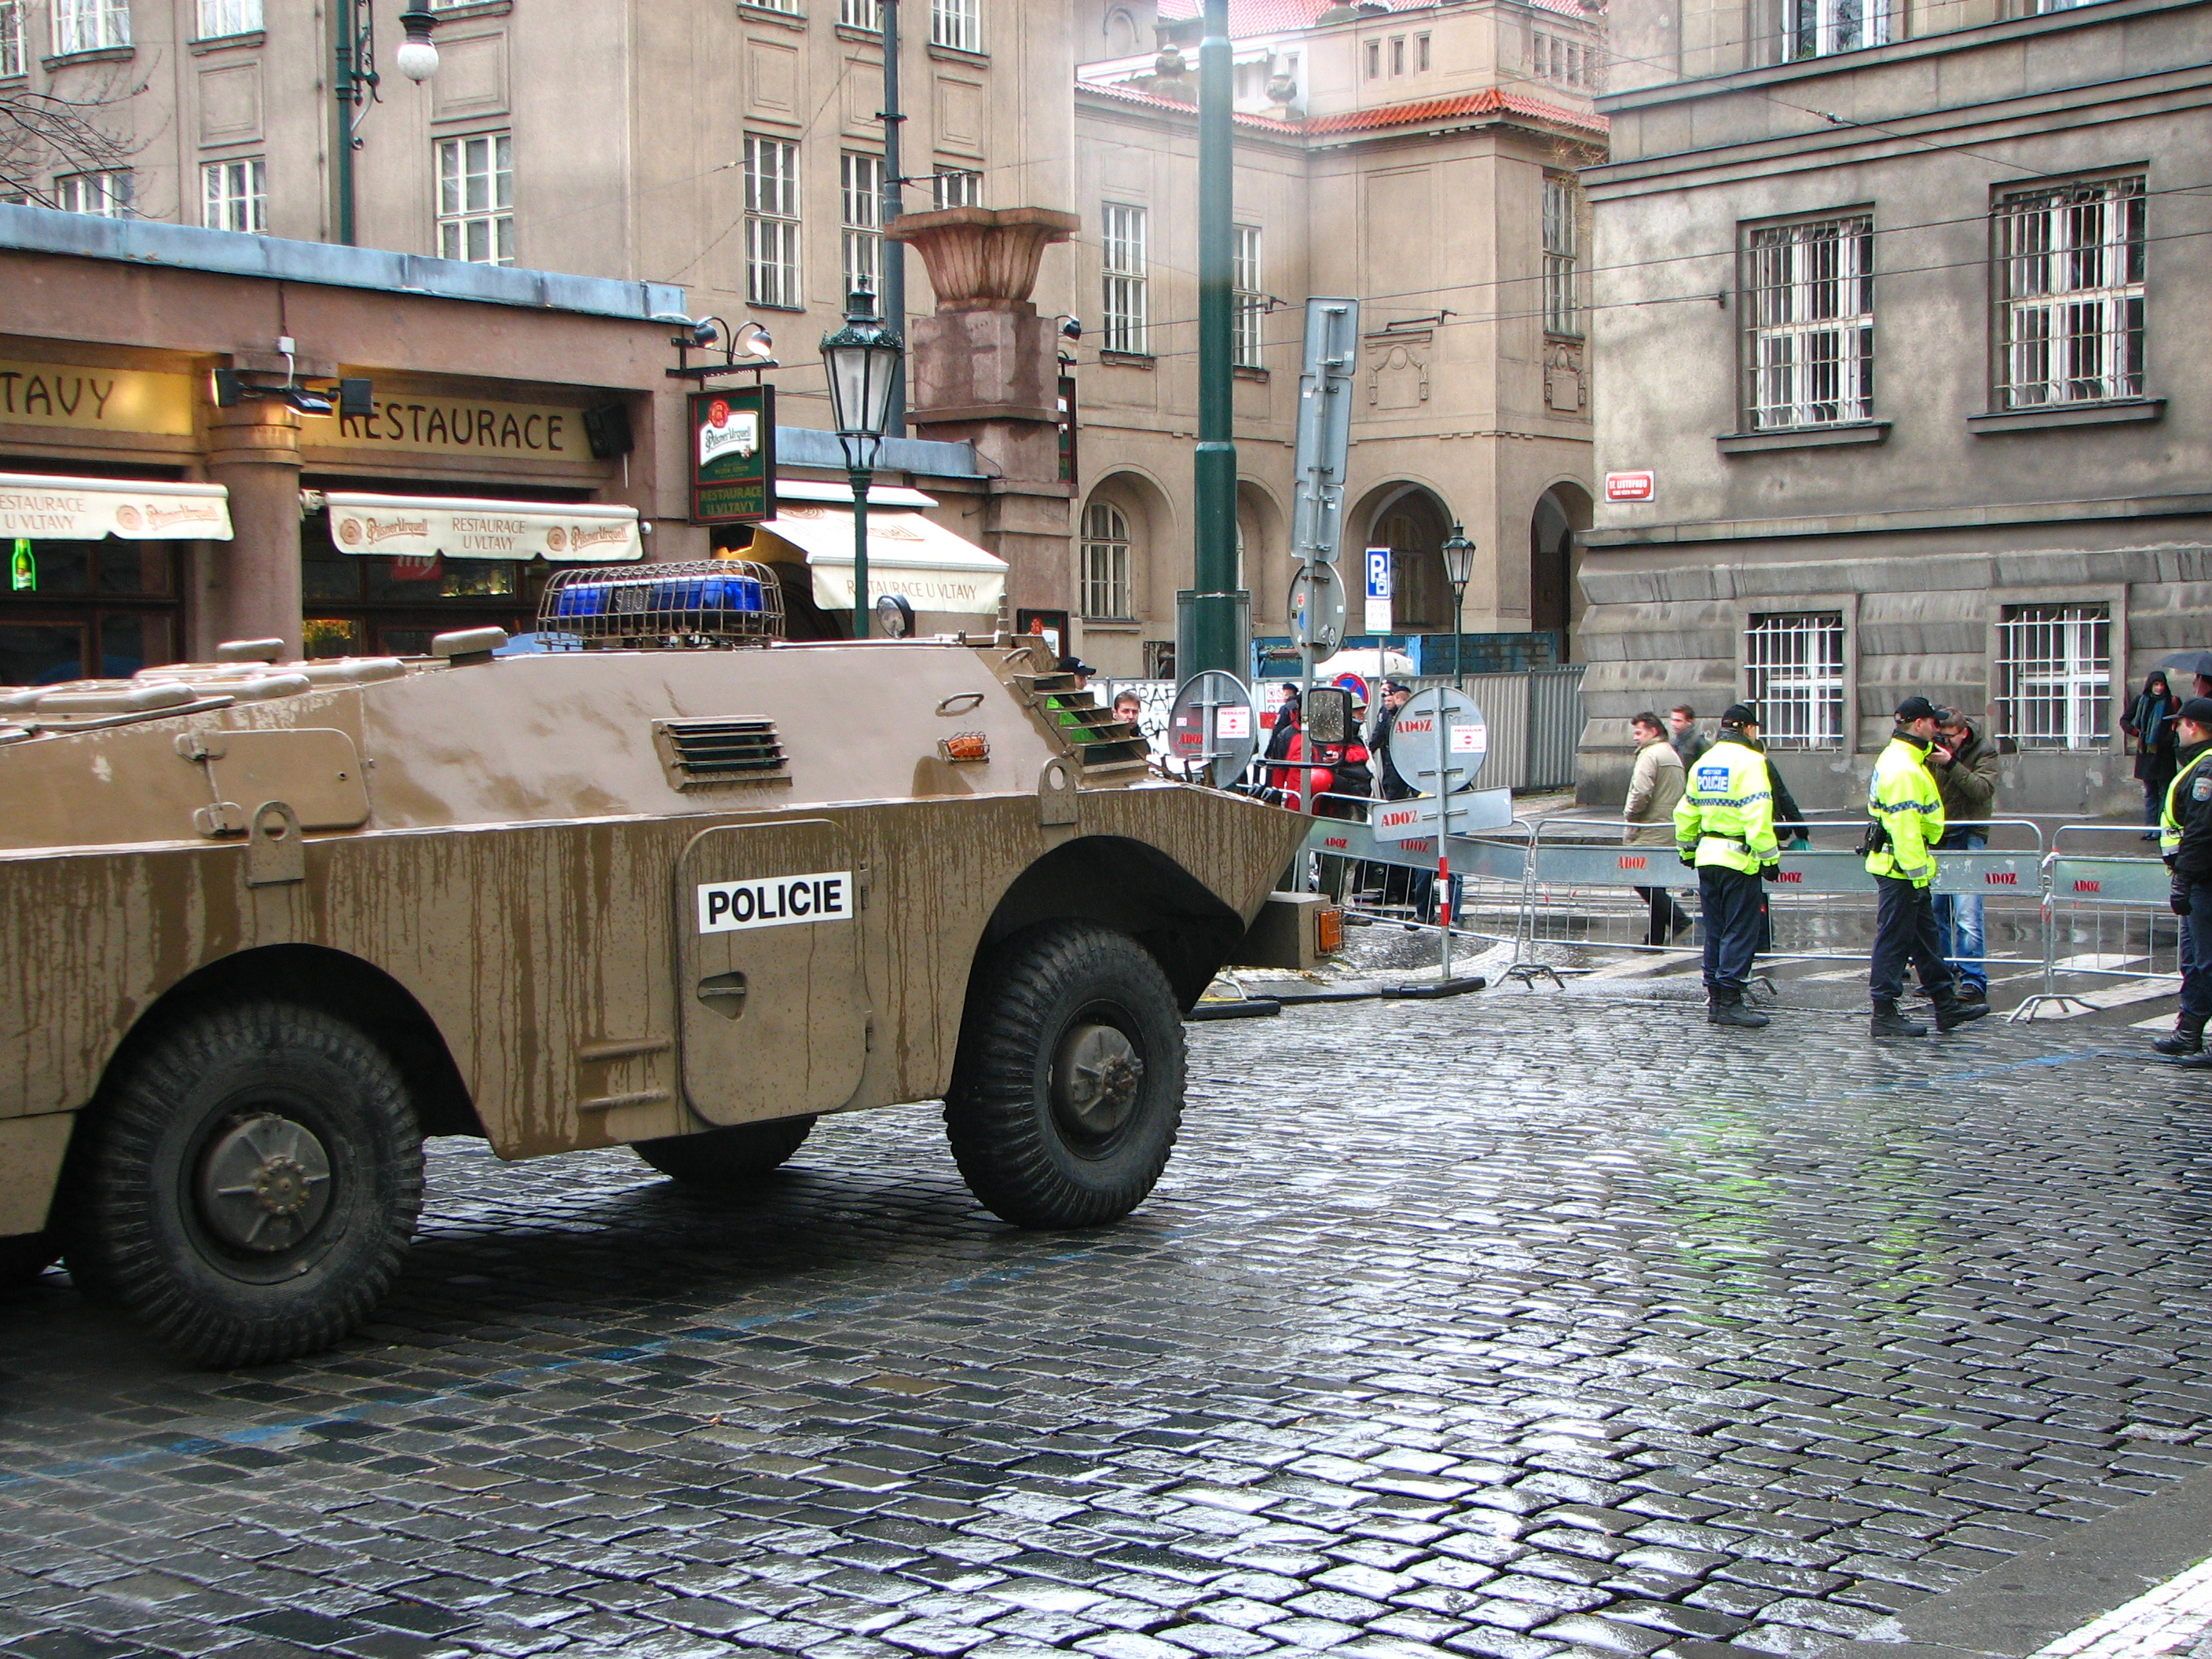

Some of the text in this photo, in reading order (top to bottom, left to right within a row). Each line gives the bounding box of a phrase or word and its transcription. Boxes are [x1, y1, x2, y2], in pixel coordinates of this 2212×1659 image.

[701, 485, 762, 501] RESTAURACE
[716, 501, 756, 515] VLTAVY
[5, 515, 75, 529] U VLTAVY
[452, 518, 526, 534] RESTAURACE
[463, 536, 515, 551] U VLTAVY
[926, 583, 936, 598] U
[936, 583, 978, 600] VLTAVY
[1395, 720, 1432, 733] ADOZ
[1698, 775, 1727, 791] POLICIE
[1381, 811, 1419, 827] ADOZ
[1324, 837, 1348, 848] ADOZ
[1619, 856, 1646, 869] ADOZ
[1776, 872, 1802, 883] DOZ
[1985, 873, 2017, 884] ADOZ
[2072, 880, 2100, 892] ADOZ
[709, 880, 842, 925] POLICIE
